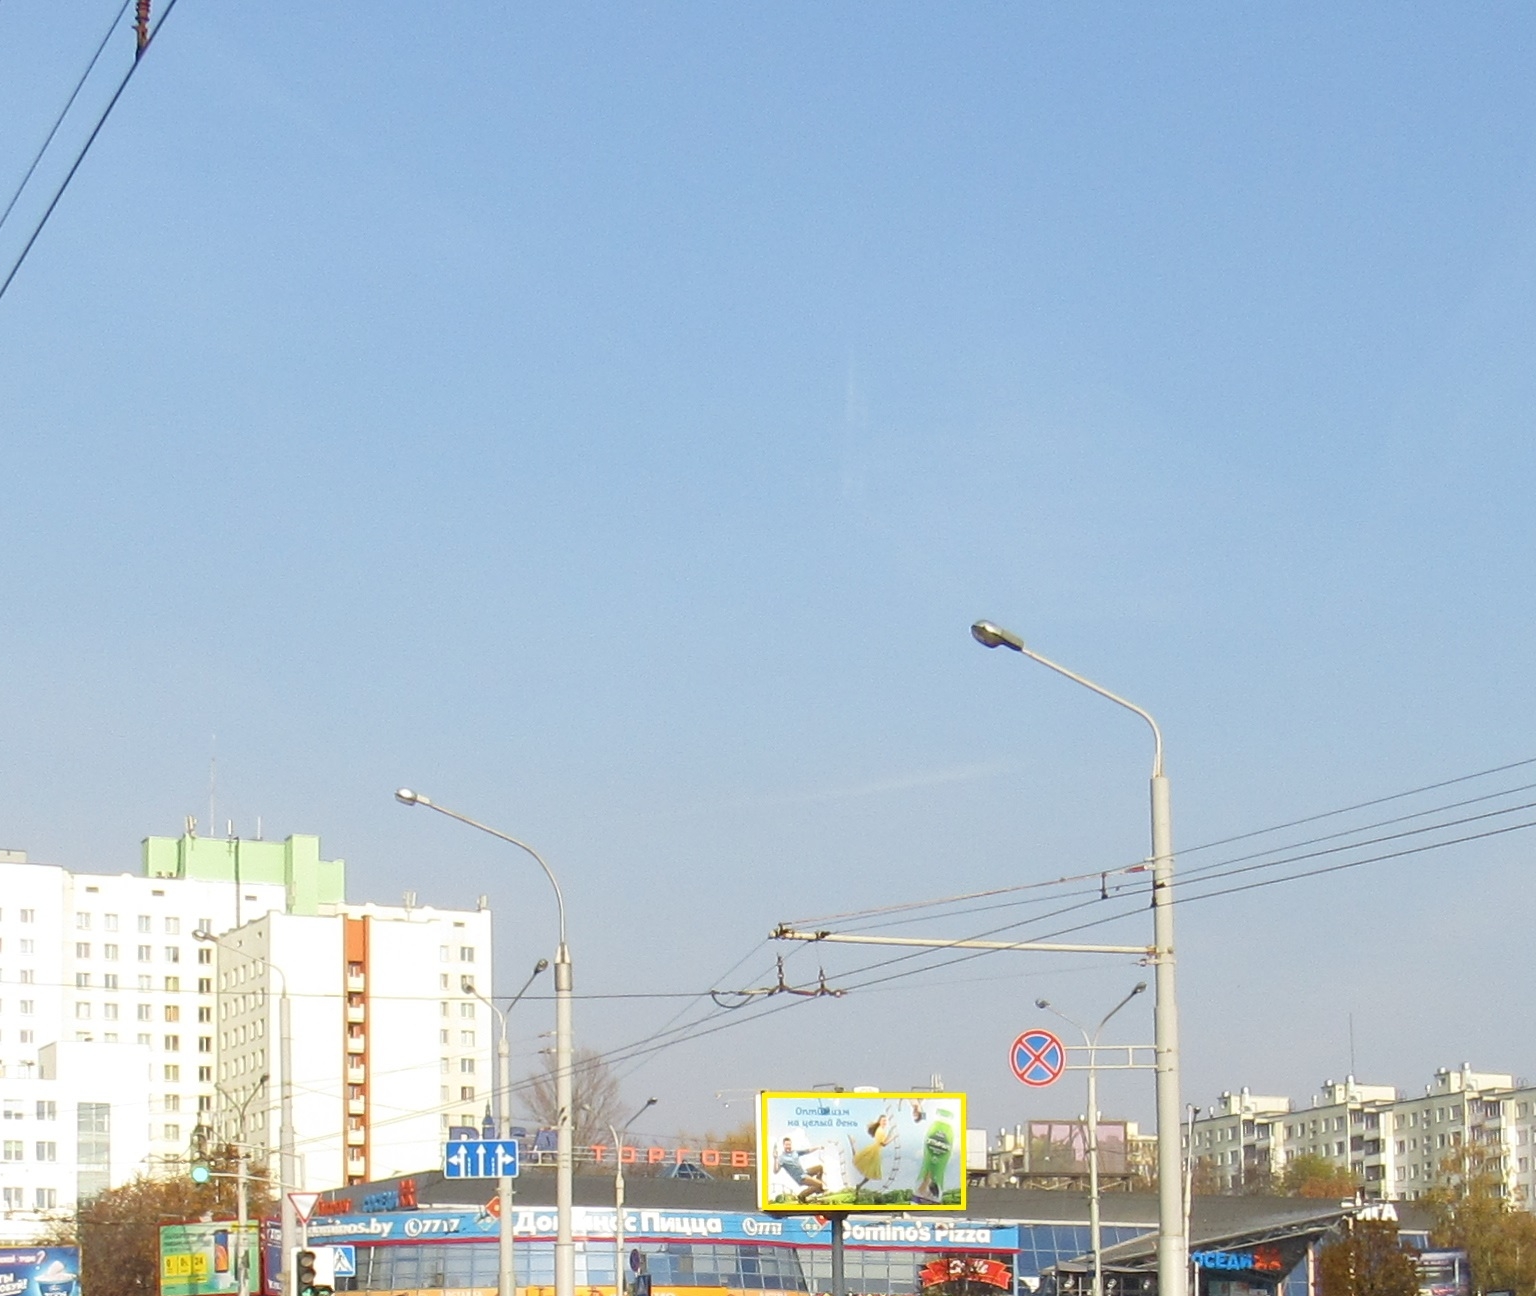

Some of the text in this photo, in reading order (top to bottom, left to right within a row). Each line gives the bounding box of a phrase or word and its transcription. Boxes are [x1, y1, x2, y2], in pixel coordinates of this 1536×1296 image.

[795, 1106, 850, 1116] Оптиизм
[787, 1118, 858, 1128] на целый день
[641, 1211, 723, 1237] Пицца
[935, 1222, 991, 1244] Pizza
